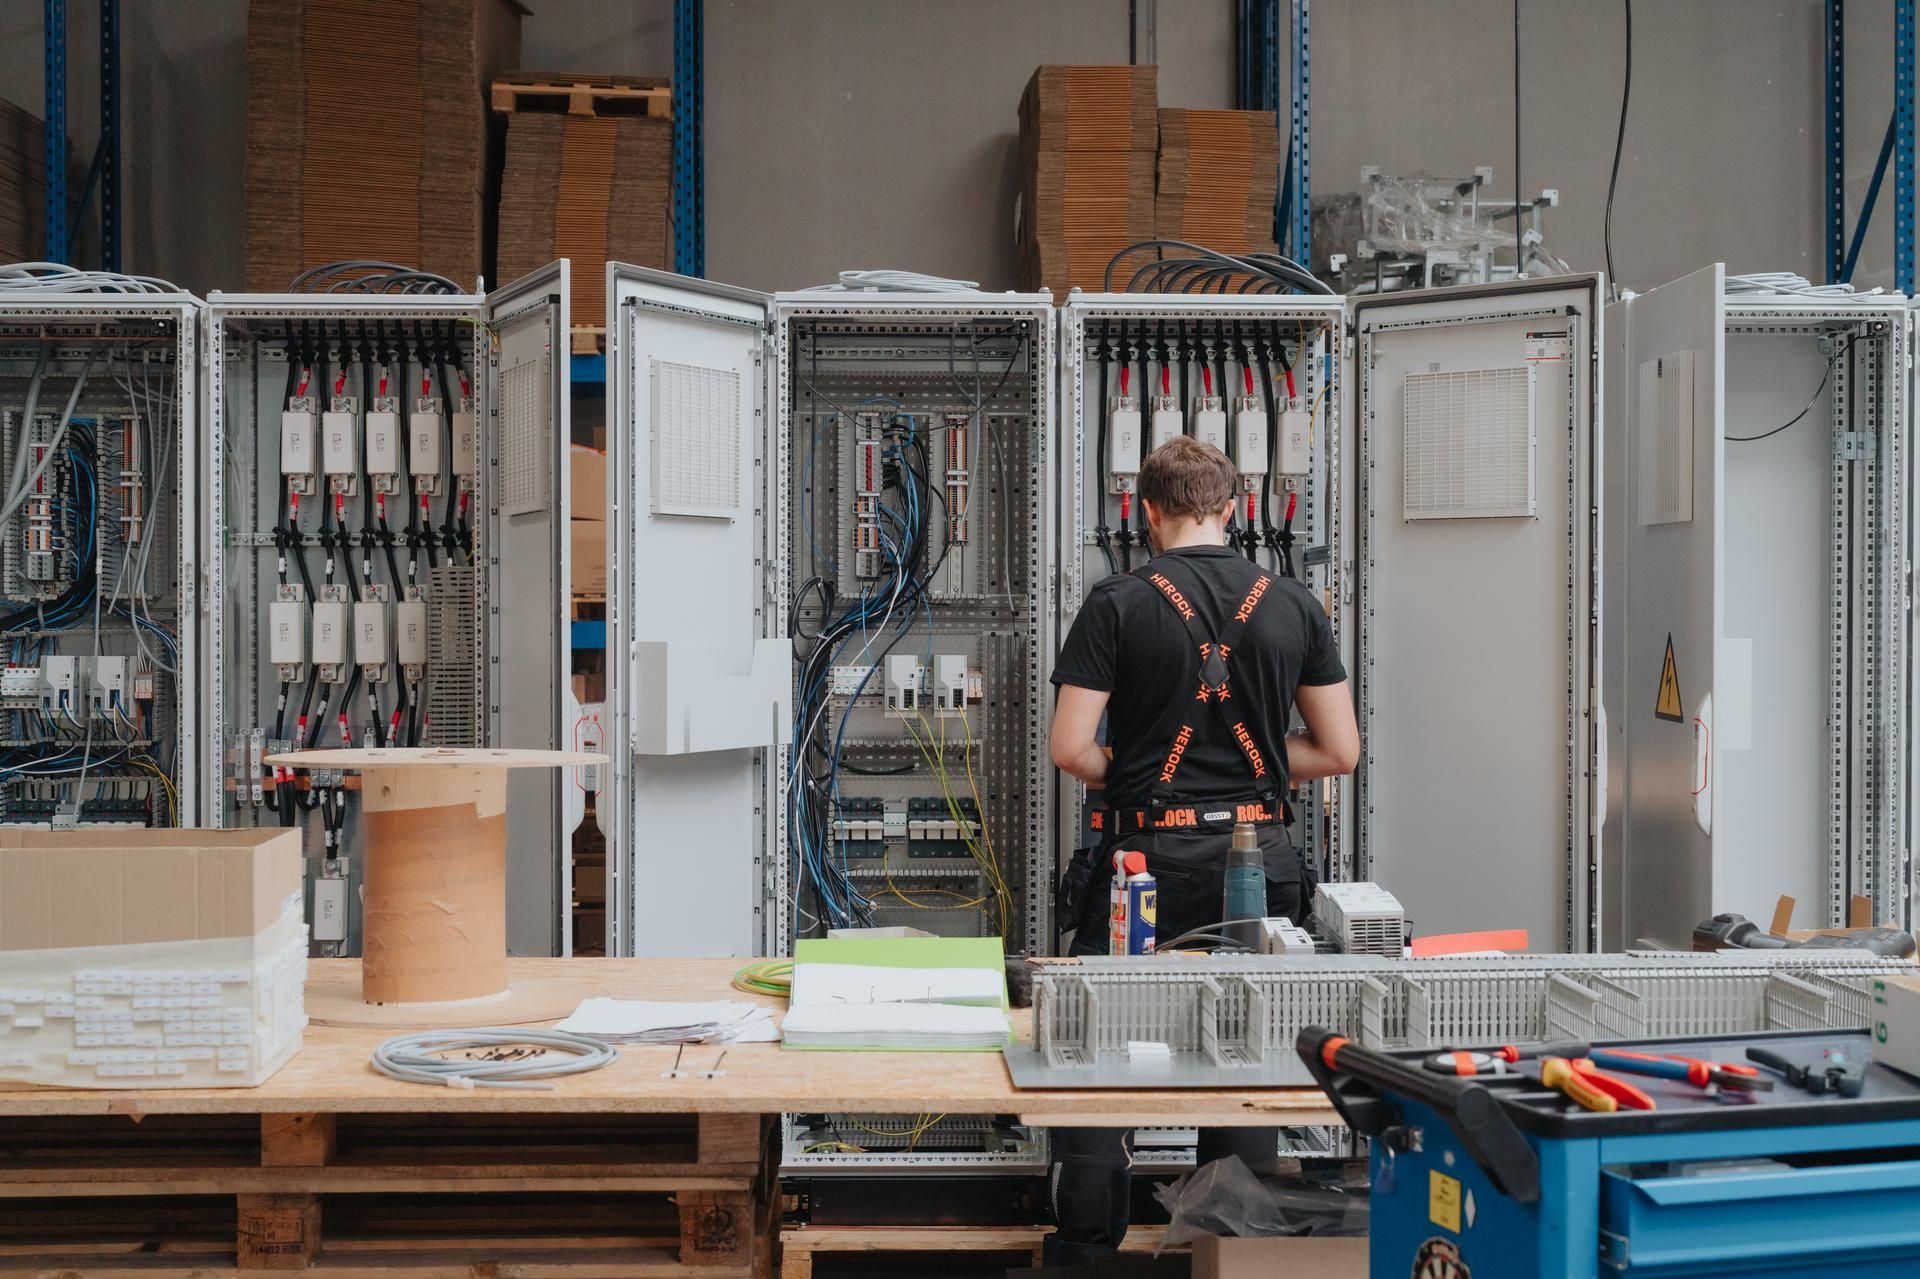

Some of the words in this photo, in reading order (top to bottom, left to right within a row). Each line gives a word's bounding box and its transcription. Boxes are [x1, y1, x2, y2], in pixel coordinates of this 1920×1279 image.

[1150, 573, 1195, 621] HEROCK
[1234, 575, 1271, 623] HEROCK
[1160, 725, 1193, 783] HEROCK
[1233, 722, 1265, 779] HEROCK
